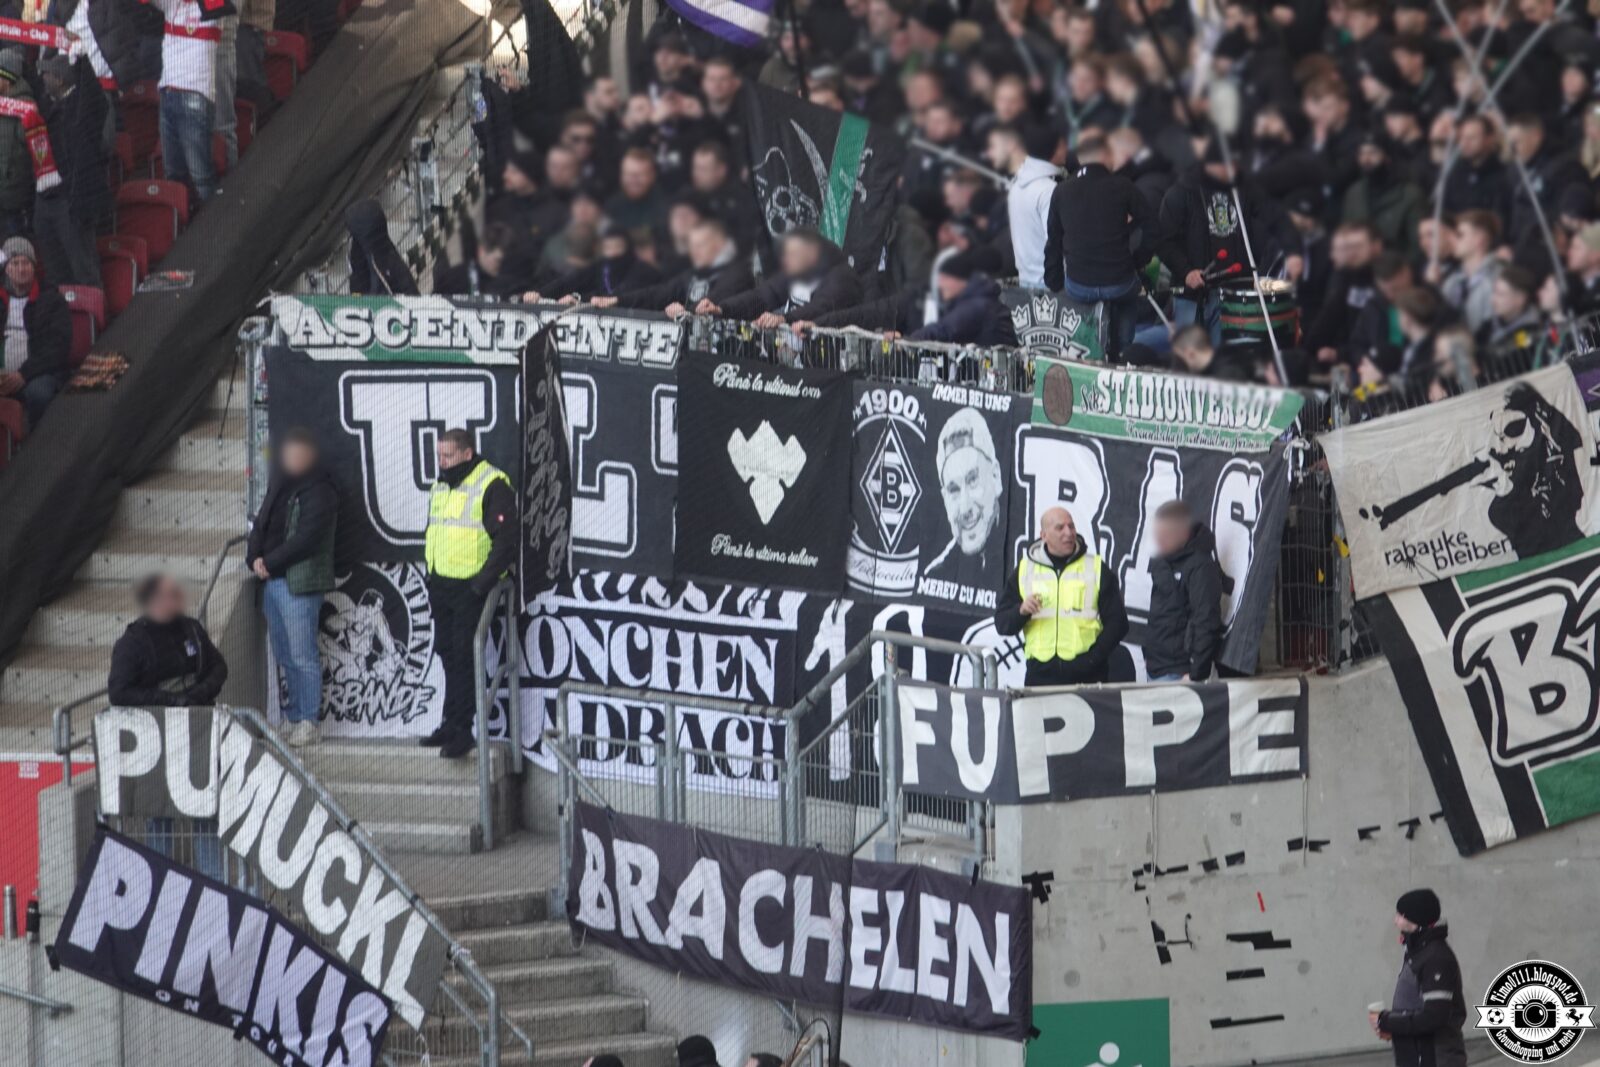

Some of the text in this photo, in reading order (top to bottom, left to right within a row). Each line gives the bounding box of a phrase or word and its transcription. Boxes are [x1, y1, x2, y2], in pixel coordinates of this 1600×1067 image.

[288, 304, 681, 368] ASCENDENTE
[1030, 332, 1060, 344] NORD
[859, 388, 919, 421] 1900
[932, 382, 1011, 413] IMMER BEI UNS
[1098, 368, 1284, 431] STADIONVERBOT
[1384, 530, 1469, 567] rabauke
[917, 576, 997, 610] MEREU CU NOI
[897, 678, 1303, 797] FUPPE
[577, 827, 1011, 1014] BRACHELEN
[156, 988, 200, 1013] ON
